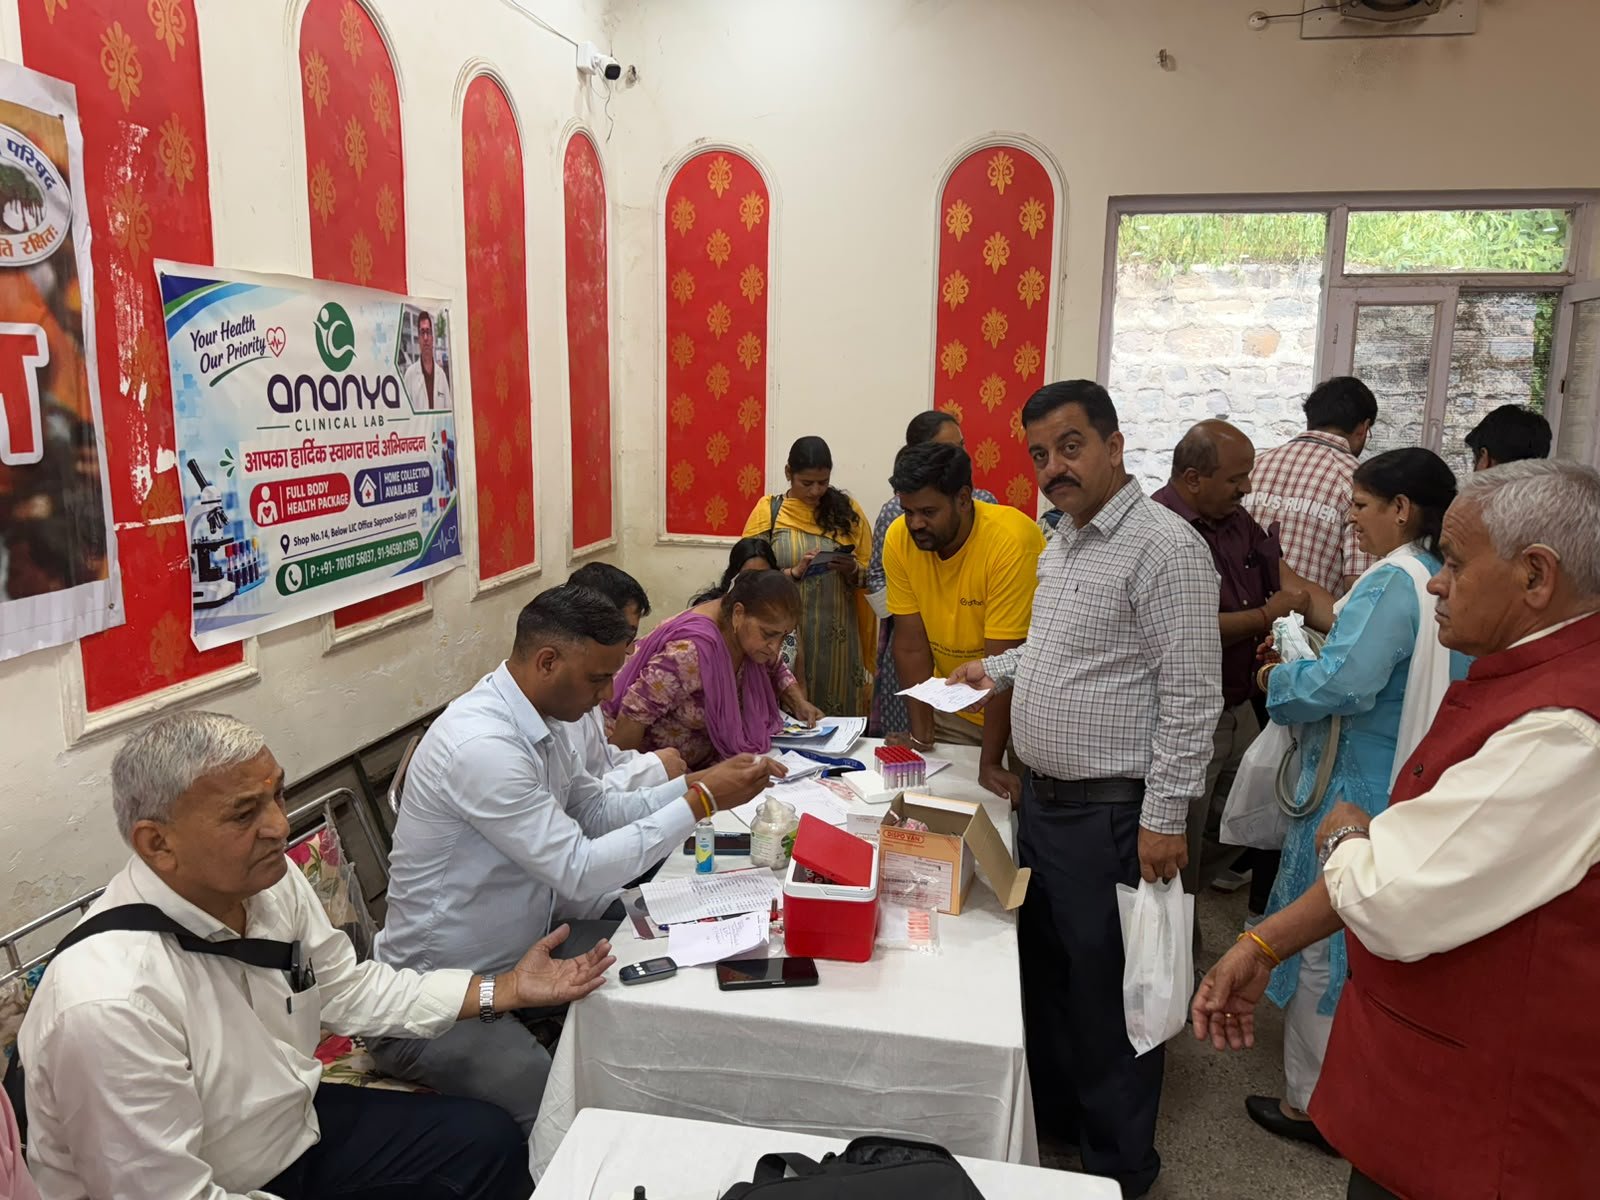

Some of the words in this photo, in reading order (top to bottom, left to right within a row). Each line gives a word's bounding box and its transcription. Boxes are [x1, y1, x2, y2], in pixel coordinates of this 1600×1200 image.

[6, 138, 57, 191] परिषद
[190, 329, 218, 352] Your
[220, 314, 256, 341] Health
[200, 351, 224, 374] Our
[226, 337, 267, 364] Priority
[295, 417, 358, 432] CLINICAL
[364, 415, 385, 427] LAB
[244, 448, 288, 473] आपका
[290, 438, 327, 468] हार्दिक
[328, 441, 364, 464] स्वागत
[365, 434, 381, 459] एवं
[381, 431, 426, 457] अभिनन्दन
[384, 471, 400, 483] HOME
[401, 466, 430, 481] COLLECTION
[285, 484, 306, 500] FULL
[307, 481, 330, 495] BODY
[385, 482, 419, 498] AVAILABLE
[287, 499, 316, 516] HEALTH
[318, 493, 349, 510] PACKAGE
[1284, 497, 1338, 523] RUNNER
[293, 535, 310, 547] Shop
[331, 525, 348, 537] Below
[348, 522, 357, 532] LIC
[358, 519, 373, 530] Office
[373, 516, 394, 528] Saproon
